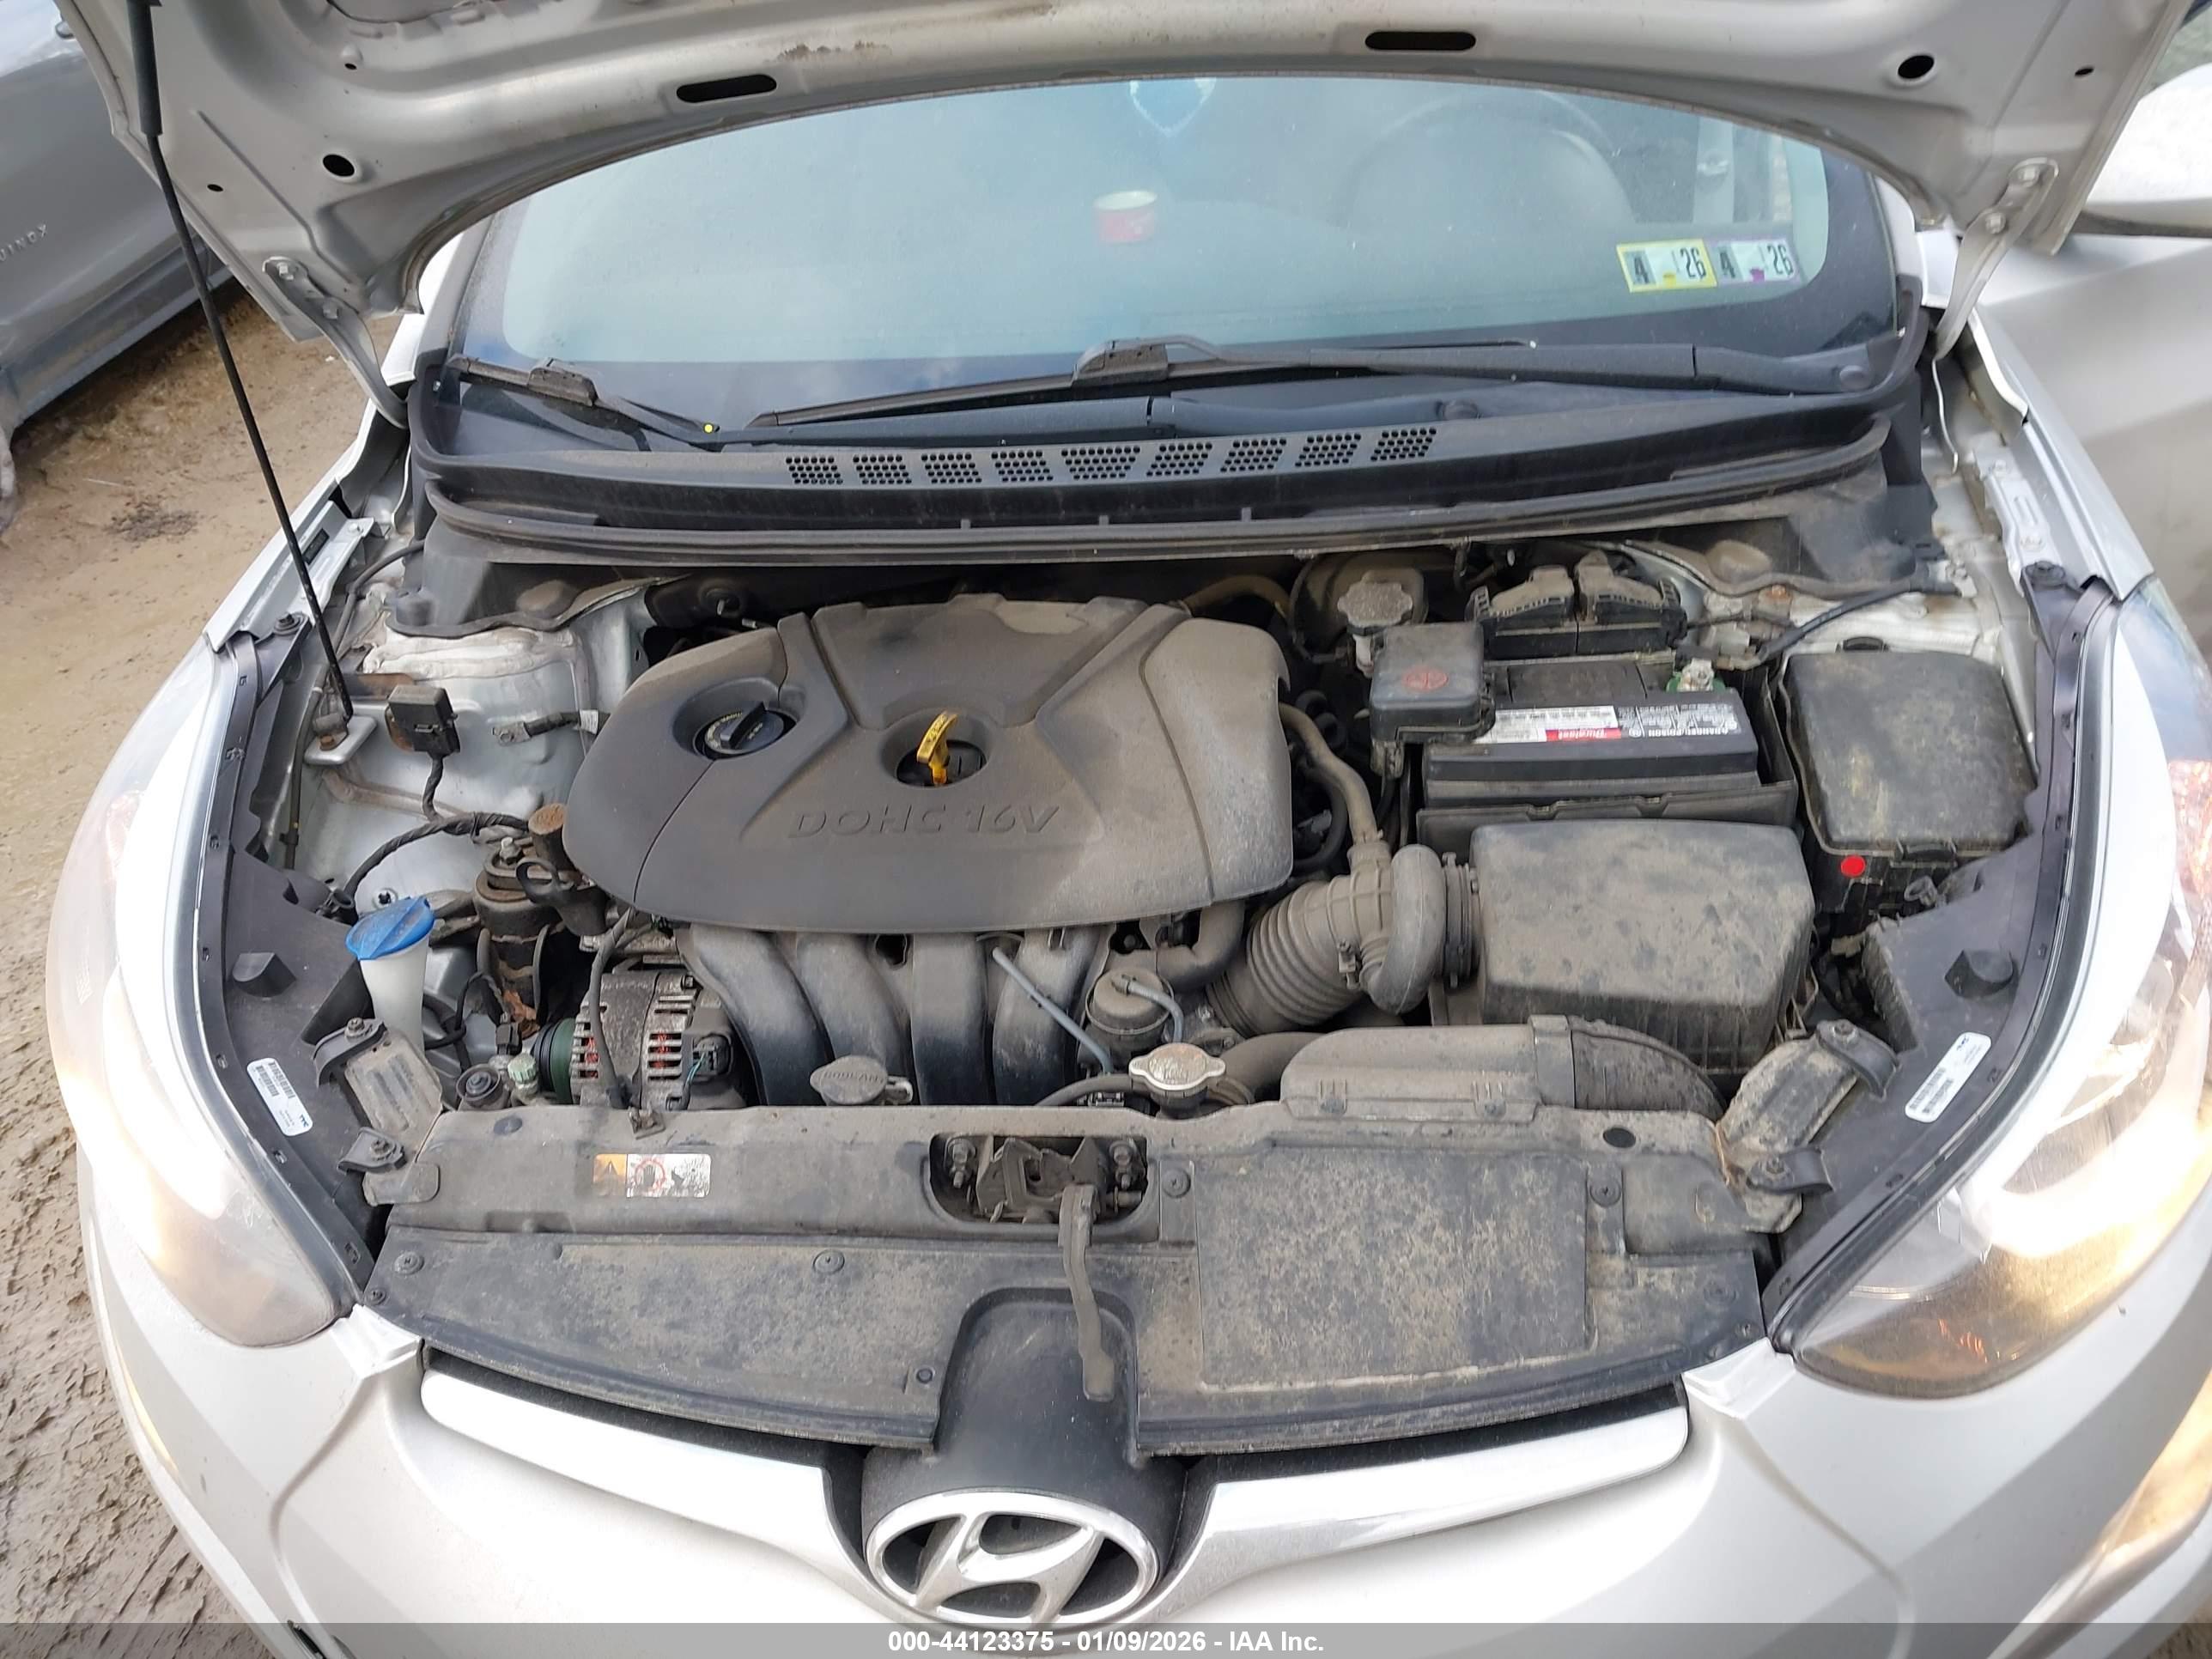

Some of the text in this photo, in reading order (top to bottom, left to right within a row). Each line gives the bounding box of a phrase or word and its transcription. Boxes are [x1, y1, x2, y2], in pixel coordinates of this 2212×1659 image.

[1633, 246, 1707, 284] 4 26
[1719, 244, 1794, 279] 4 26
[788, 804, 1060, 839] DOHC 16V
